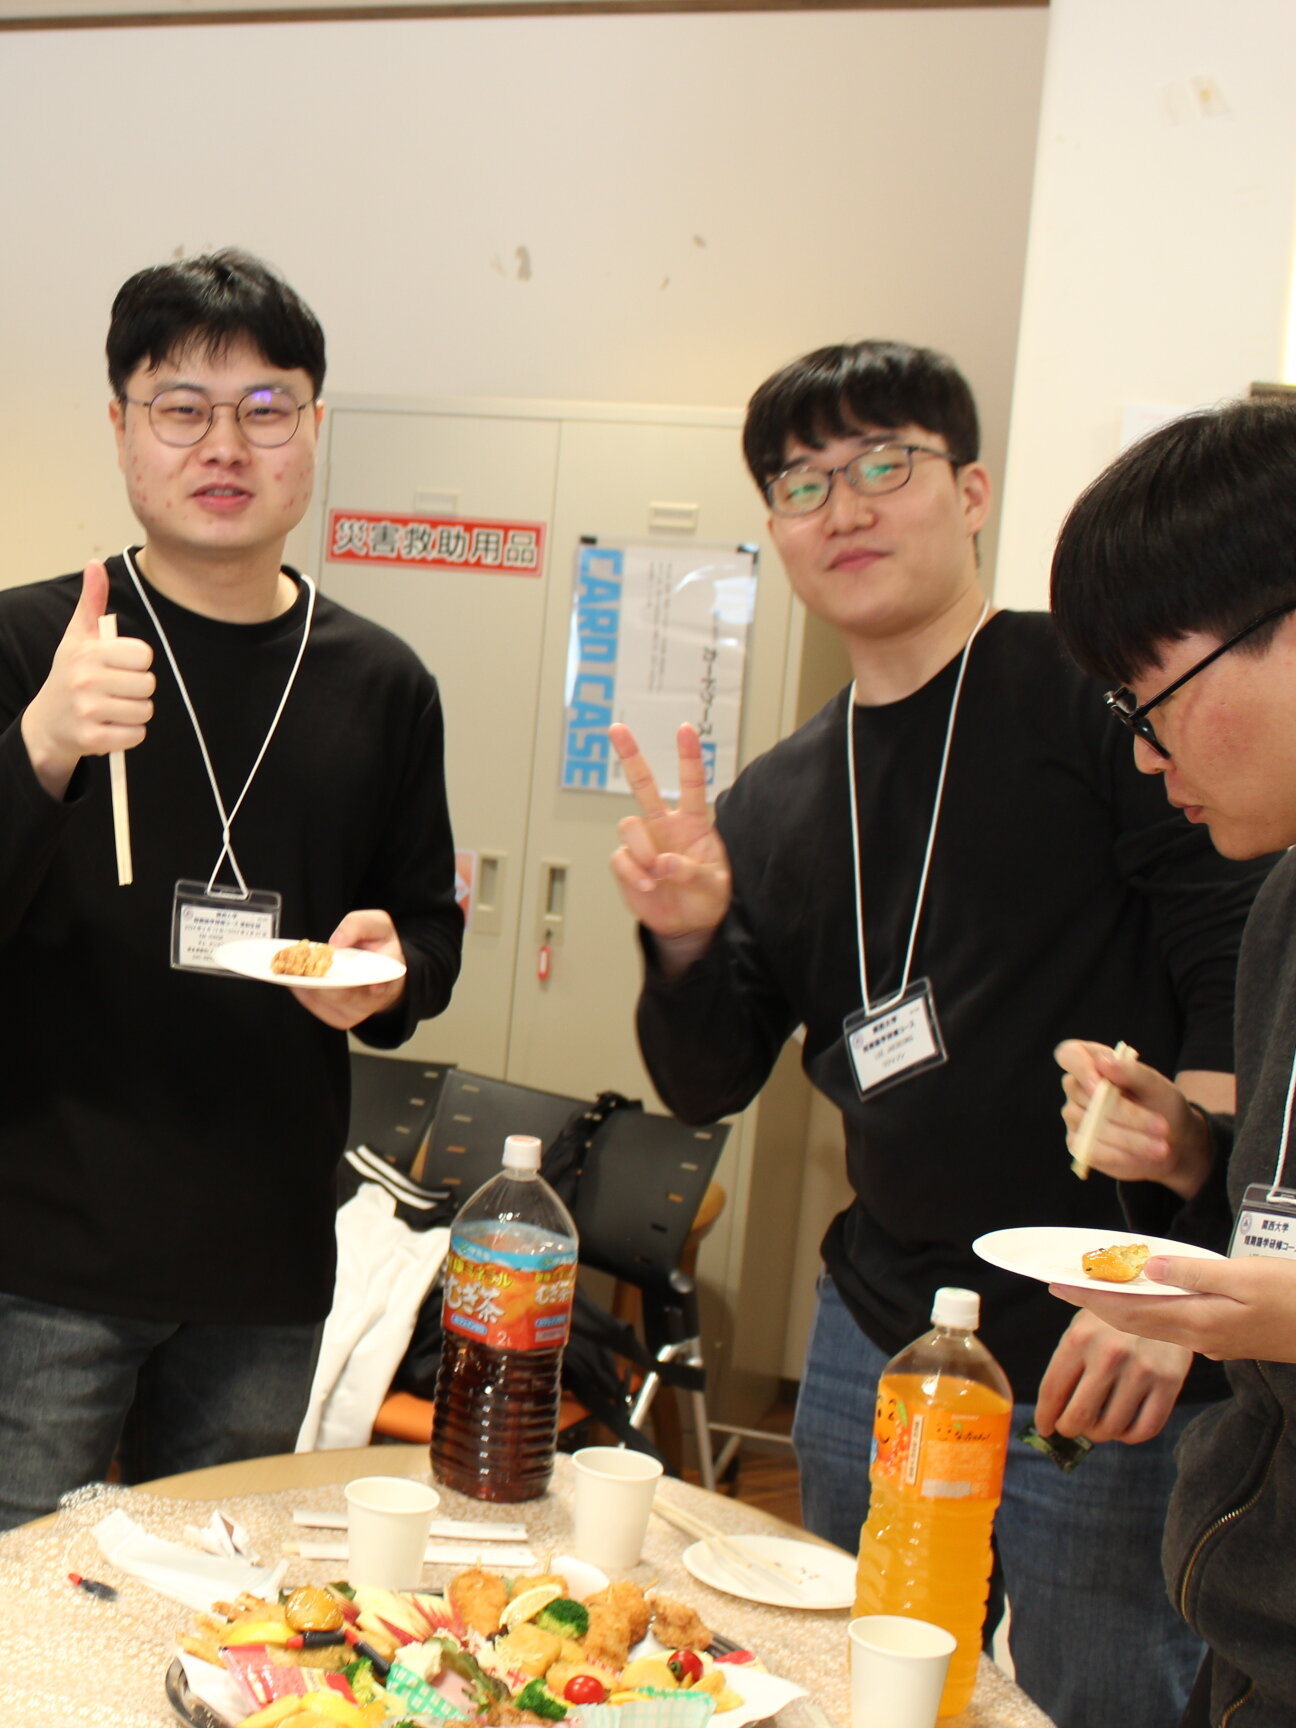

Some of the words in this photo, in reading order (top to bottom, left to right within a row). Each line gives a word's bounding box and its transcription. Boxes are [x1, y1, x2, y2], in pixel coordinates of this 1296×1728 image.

[334, 518, 538, 567] 災害救助用品
[578, 547, 624, 664] CARD
[564, 673, 616, 788] CASE
[443, 1276, 504, 1323] むぎ茶
